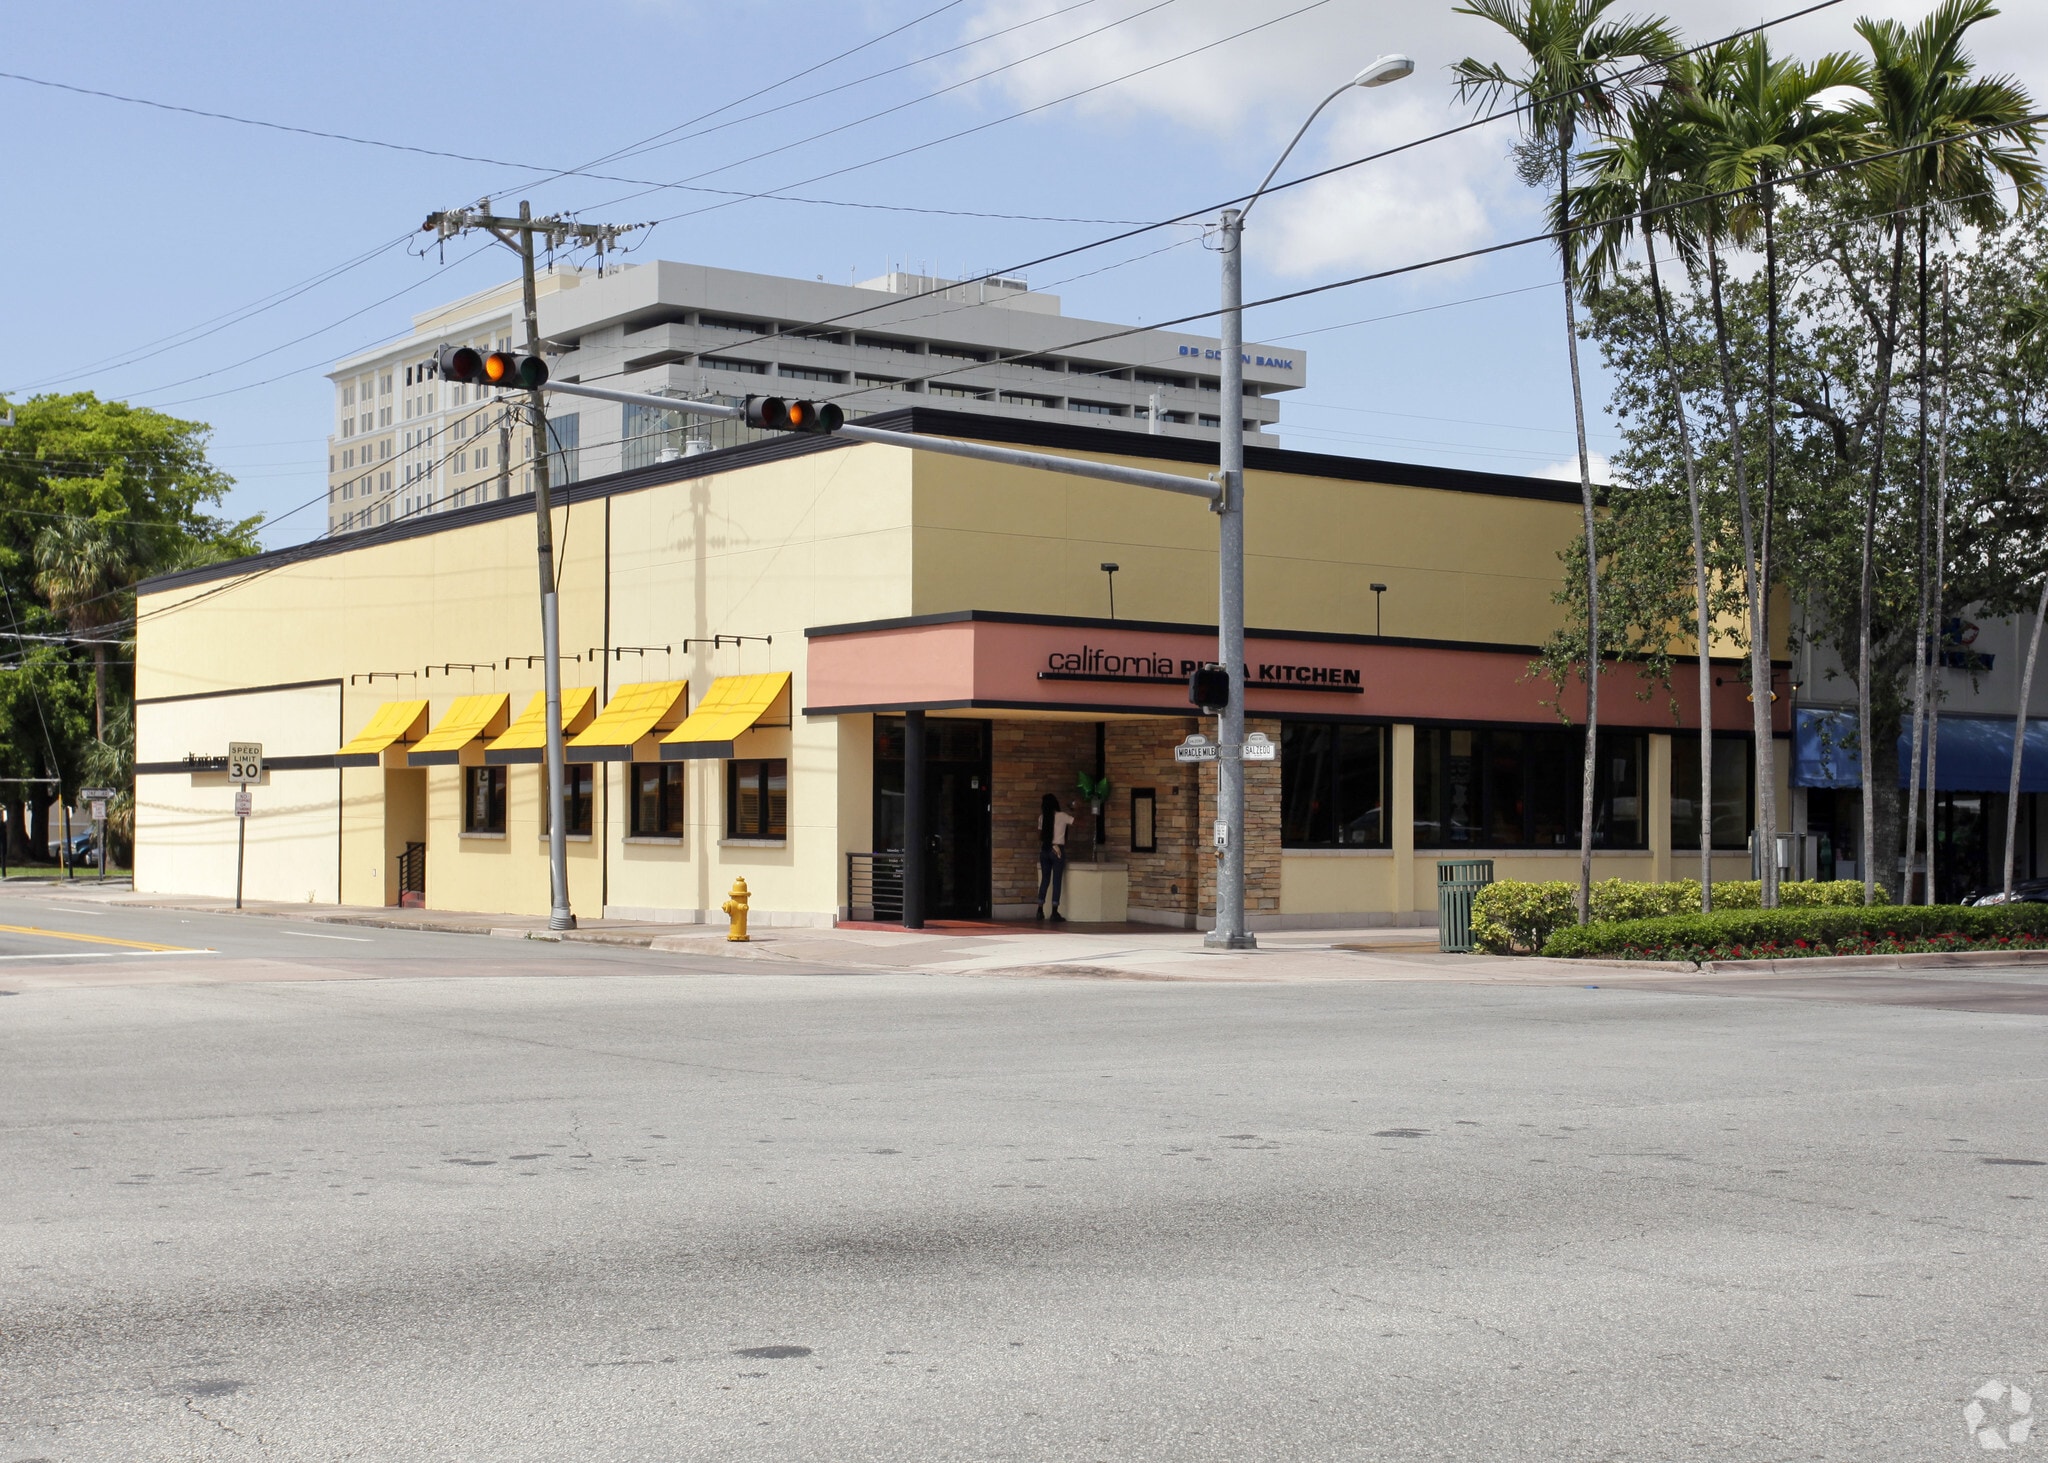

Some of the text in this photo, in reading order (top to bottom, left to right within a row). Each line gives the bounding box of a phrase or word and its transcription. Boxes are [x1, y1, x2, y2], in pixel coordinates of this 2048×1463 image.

[1205, 349, 1251, 364] OCN
[1255, 356, 1293, 370] BANK
[1048, 645, 1173, 675] california
[1258, 664, 1361, 684] KITCHEN
[1178, 748, 1202, 757] MIRACLE
[1245, 745, 1270, 755] SALZEDO
[231, 763, 258, 778] 30
